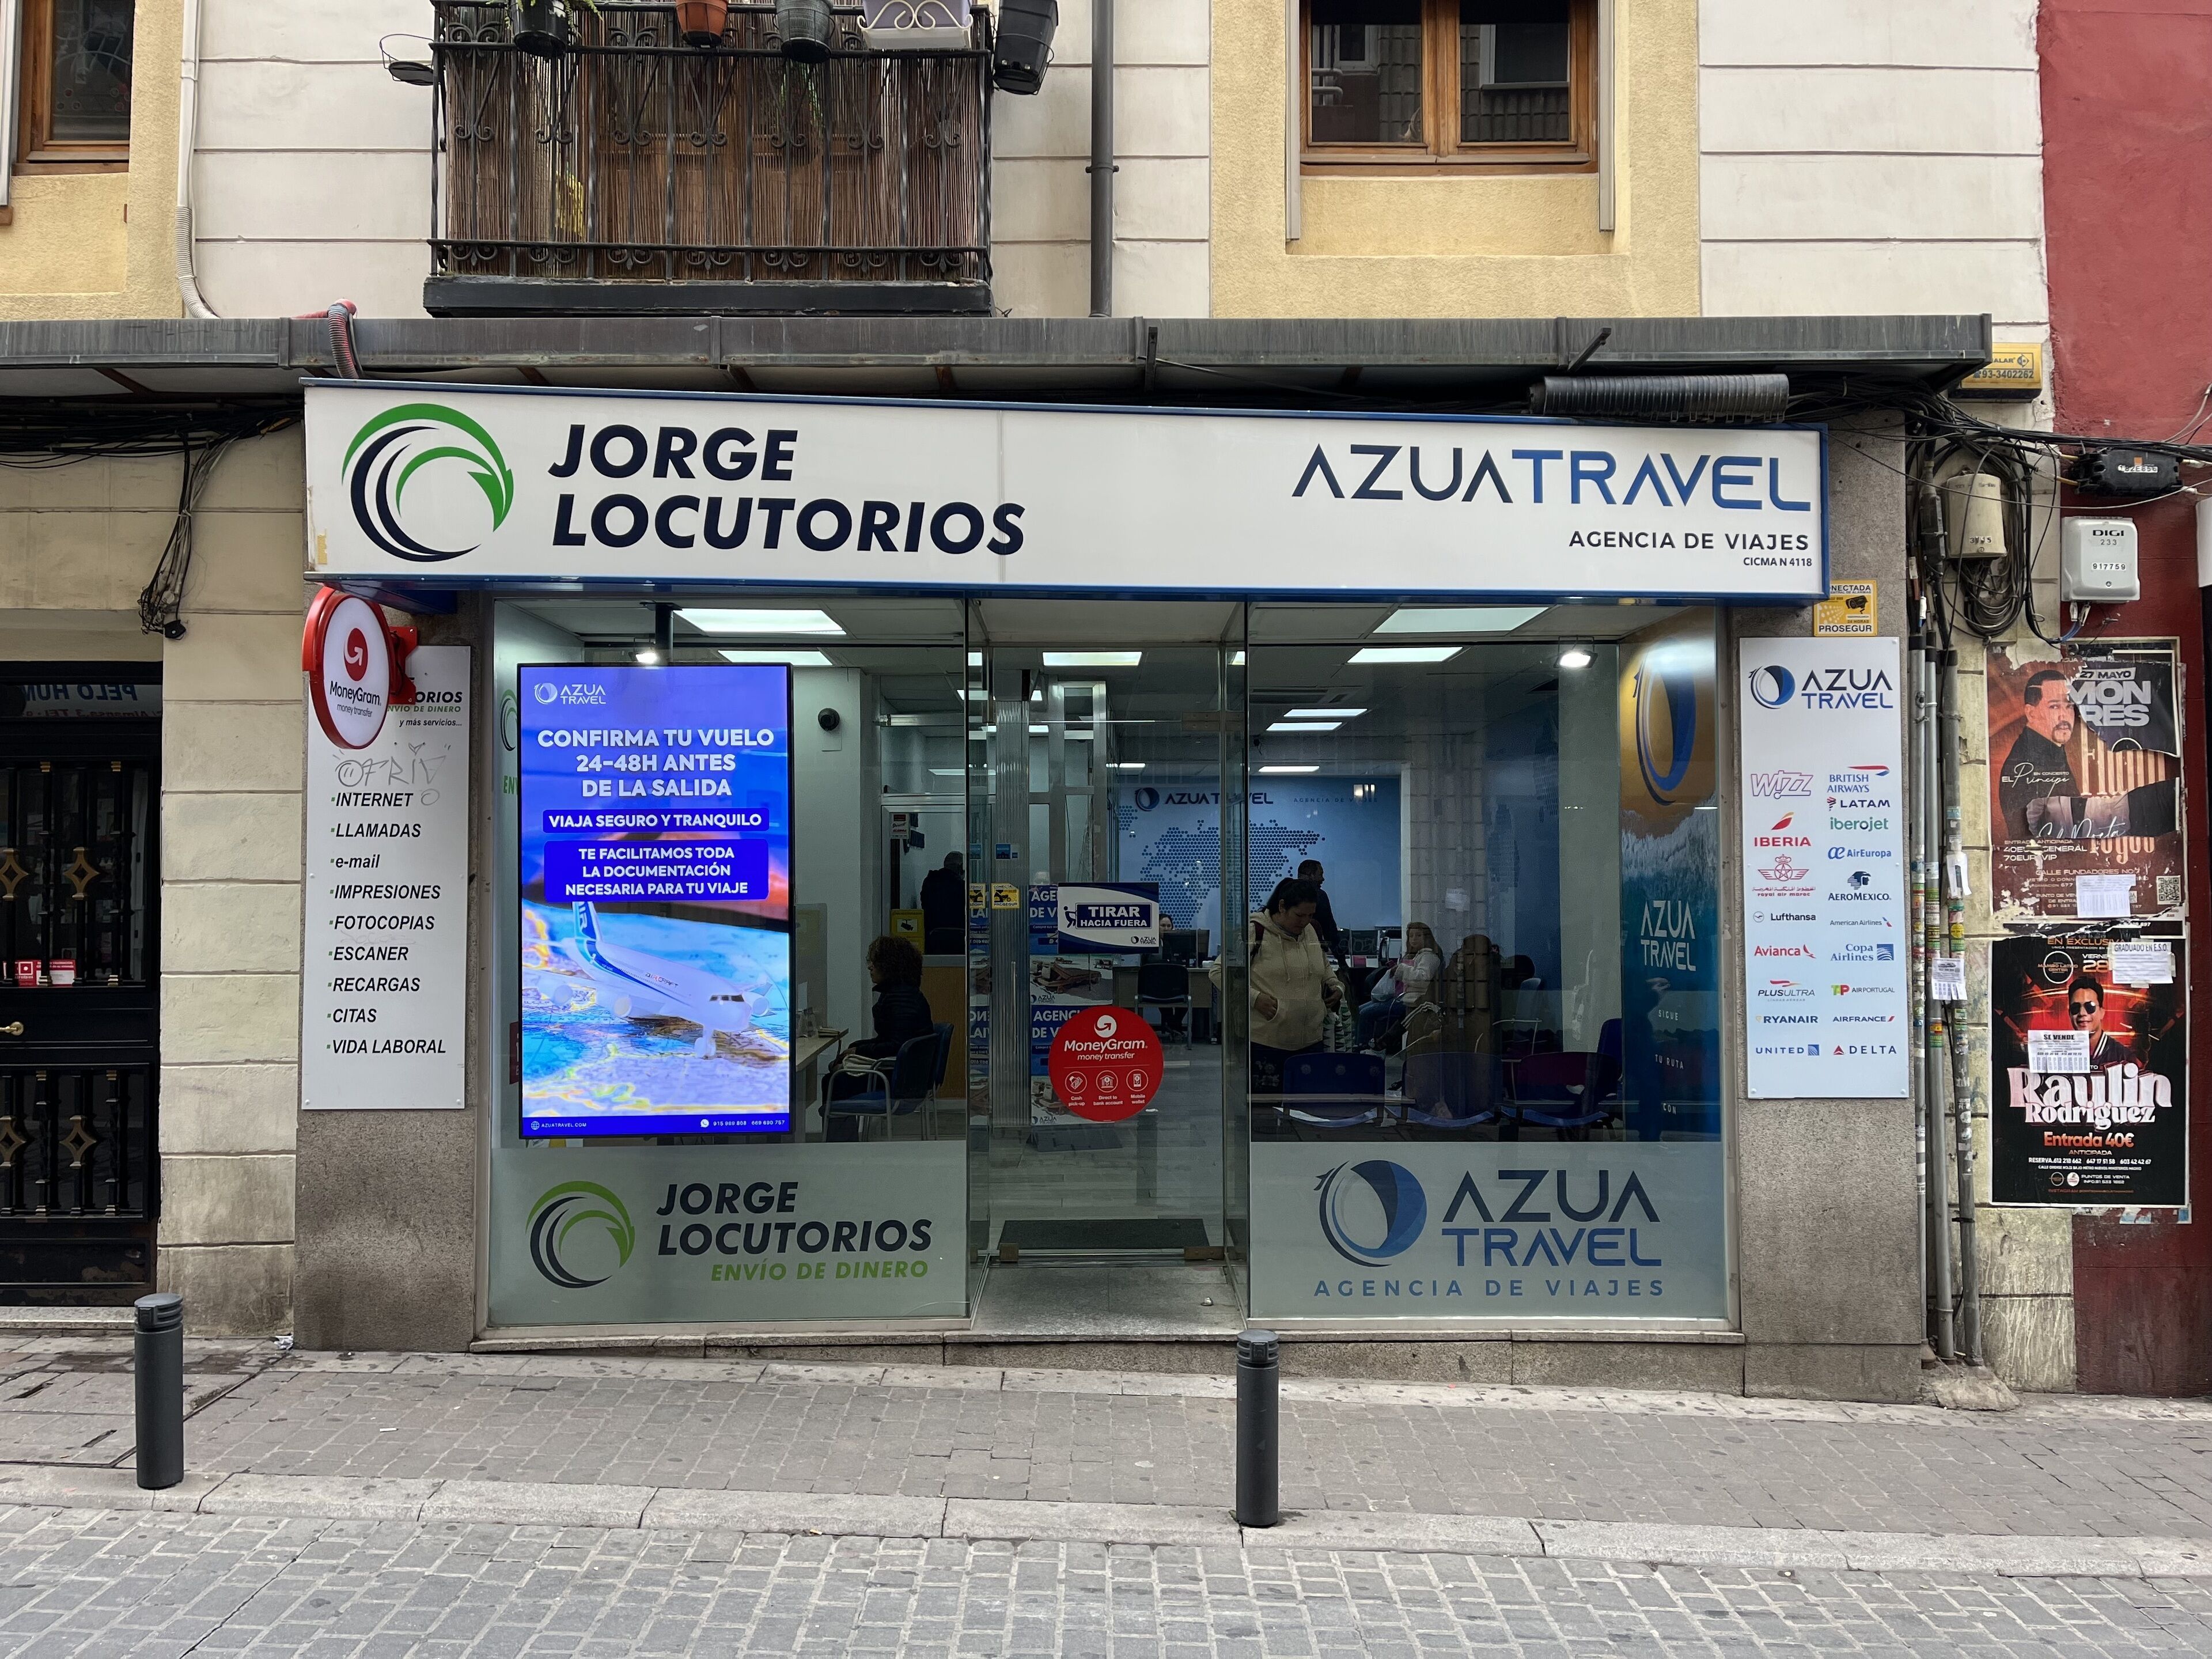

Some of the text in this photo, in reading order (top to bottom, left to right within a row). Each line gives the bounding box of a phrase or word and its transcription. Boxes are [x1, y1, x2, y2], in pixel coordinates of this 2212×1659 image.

[1982, 370, 2033, 378] 93-3402262
[548, 424, 798, 482] JORGE
[552, 493, 1026, 556] LOCUTORIOS
[1569, 531, 1809, 550] AGENCIA DE VIAJES
[1743, 557, 1812, 566] CICMA N 4118
[1802, 669, 1893, 691] AZUA
[2098, 671, 2131, 679] MAYO
[329, 681, 381, 706] MoneyGram
[416, 691, 463, 703] ORIOS
[560, 684, 606, 696] AZUA
[560, 695, 607, 704] TRAVEL
[1801, 693, 1893, 709] TRAVEL
[337, 703, 373, 718] money transfer
[537, 729, 774, 747] CONFIRMA TU VUELO
[576, 754, 736, 772] 24-48H ANTES
[1830, 774, 1869, 782] BRITISH
[582, 779, 732, 797] DE LA SALIDA
[1827, 785, 1870, 793] AIRWAYS
[335, 793, 414, 806] INTERNET
[1840, 800, 1891, 808] LATAM
[548, 813, 762, 828] VIAJA SEGURO Y TRANQUILO
[1830, 817, 1889, 832] iberojet
[335, 824, 422, 838] LLAMADAS
[1754, 836, 1812, 847] IBERIA
[578, 847, 734, 860] TE FACILITAMOS TODA
[1847, 849, 1892, 859] AirEuropa
[335, 854, 380, 868] e-mail
[583, 862, 731, 877] LA DOCUMENTACIÓN
[334, 885, 441, 899] IMPRESIONES
[565, 882, 748, 896] NECESARIA PARA TU VIAJE
[1030, 907, 1044, 918] DE
[1088, 907, 1140, 917] TIRAR
[334, 916, 435, 930] FOTOCOPIAS
[1641, 900, 1695, 939] AZUA
[334, 946, 408, 961] ESCANER
[1754, 946, 1801, 956] Avianca
[1846, 944, 1873, 952] Copa
[1641, 940, 1696, 971] TRAVEL
[1831, 953, 1874, 961] Airlines
[333, 978, 421, 992] RECARGAS
[1831, 984, 1850, 995] TAP
[333, 1009, 377, 1023] CITAS
[1763, 1016, 1819, 1024] RYANAIR
[1032, 1027, 1047, 1038] DE
[333, 1039, 446, 1054] VIDA LABORAL
[1065, 1039, 1145, 1053] MoneyGram
[1849, 1046, 1897, 1054] DELTA
[1655, 1054, 1684, 1069] TU RUTA
[2007, 1063, 2173, 1108] Raulin
[1663, 1103, 1676, 1115] CON
[2025, 1101, 2156, 1130] Rodriguez
[2044, 1131, 2134, 1147] Entrada 40€
[656, 1182, 798, 1216] JORGE
[1442, 1170, 1661, 1222] AZUA
[658, 1219, 933, 1256] LOCUTORIOS
[1442, 1228, 1662, 1266] TRAVEL
[711, 1259, 929, 1281] ENVÍO DE DINERO
[1313, 1279, 1664, 1297] AGENCIA DE VIAJES
